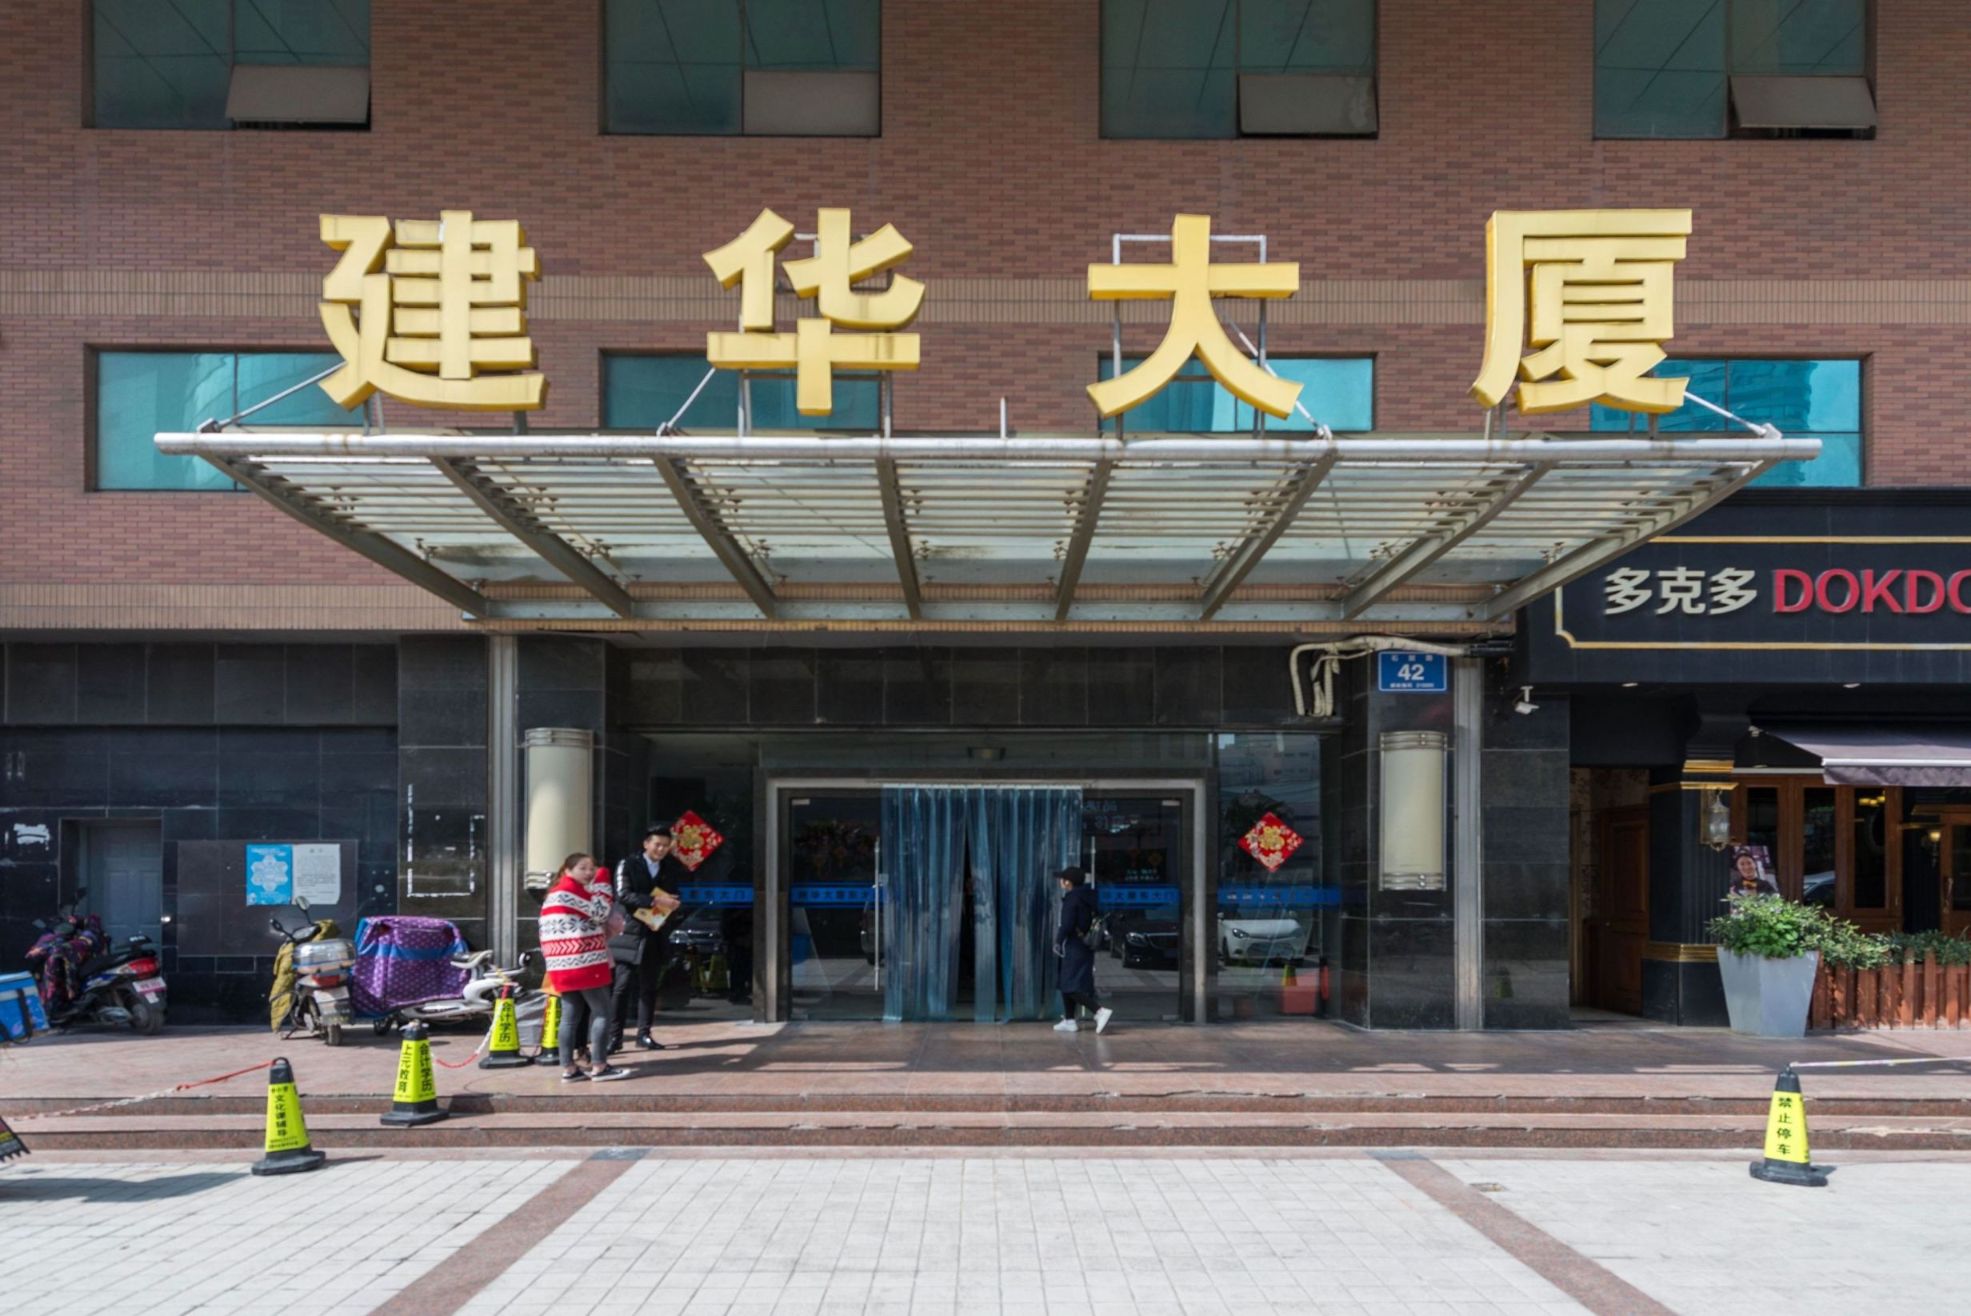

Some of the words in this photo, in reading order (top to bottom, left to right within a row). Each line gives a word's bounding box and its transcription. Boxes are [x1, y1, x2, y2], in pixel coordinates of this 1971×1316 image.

[318, 207, 1693, 419] 建华大厦
[1603, 566, 1758, 616] 多克多
[1397, 663, 1425, 681] 42
[1776, 1097, 1792, 1155] 禁止停车
